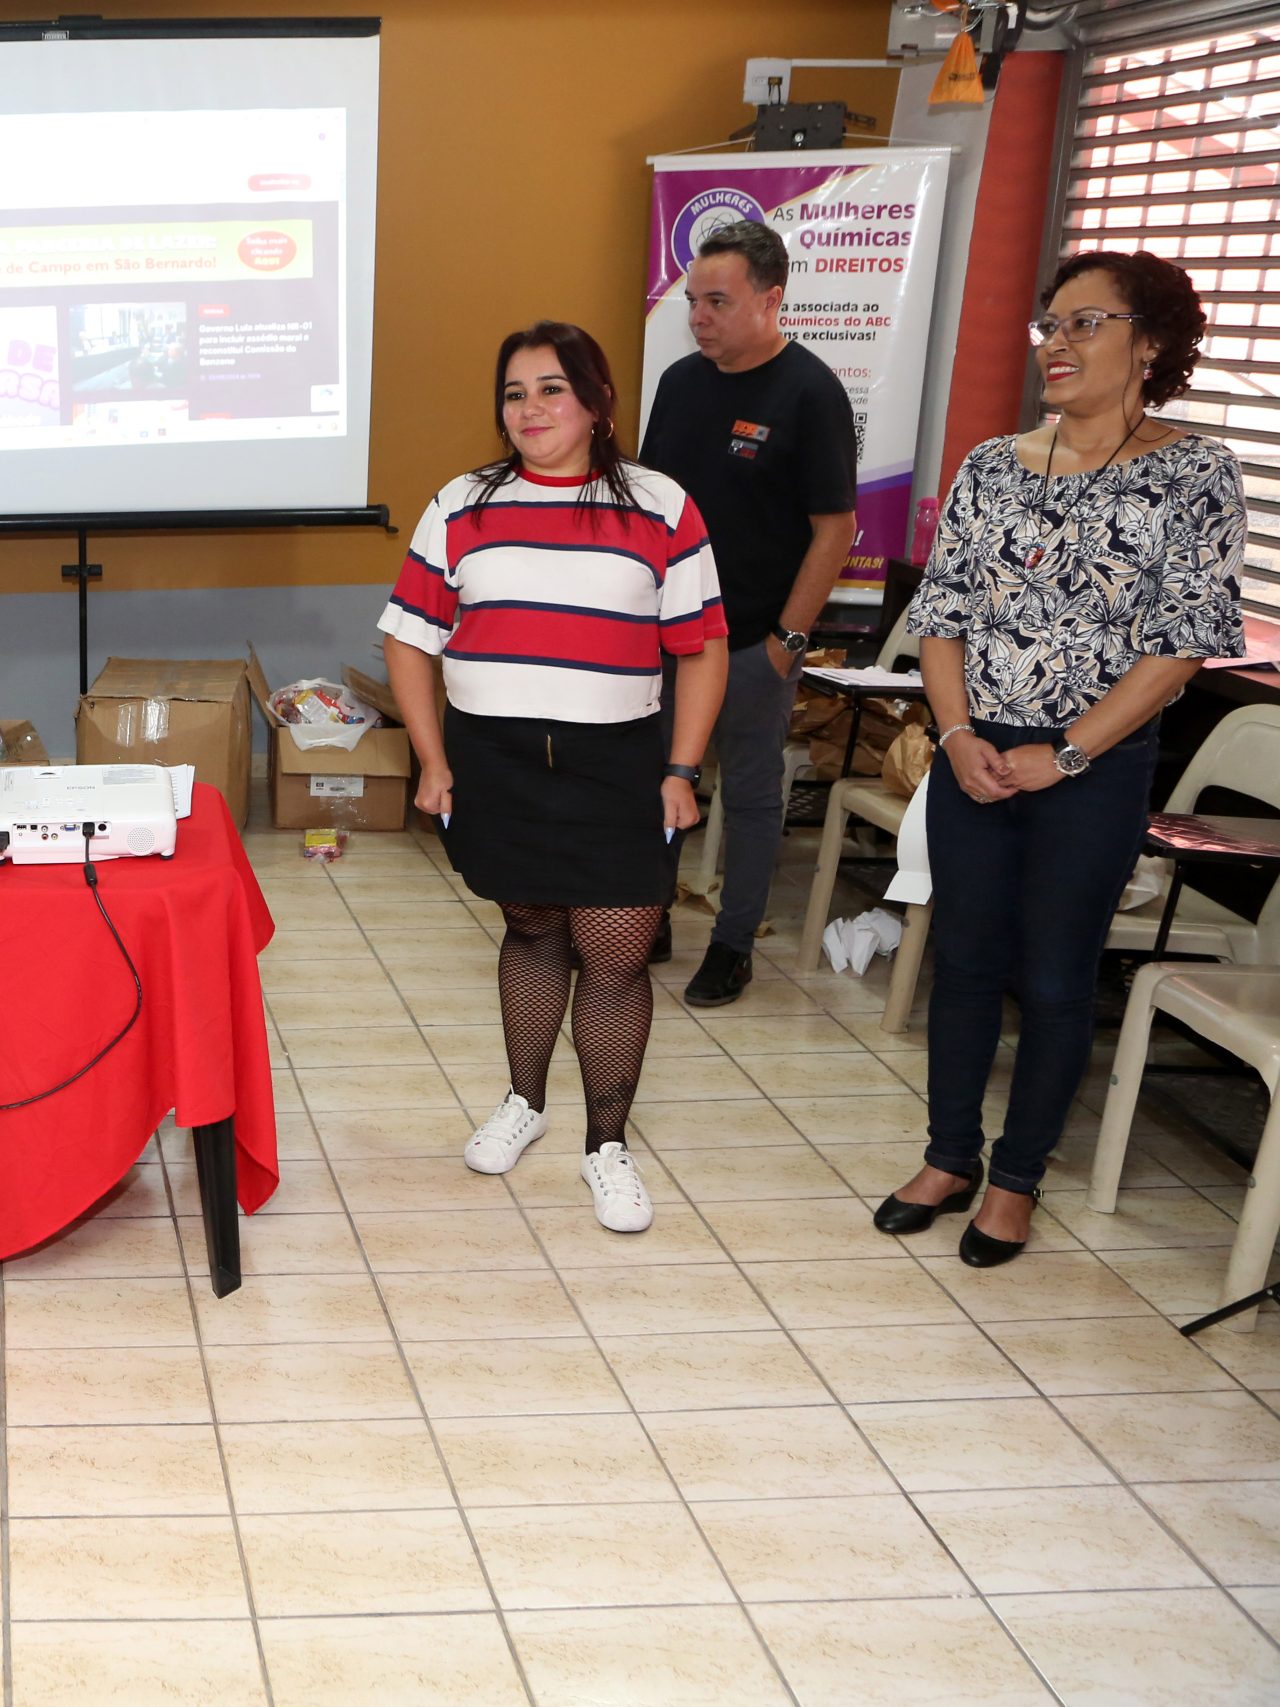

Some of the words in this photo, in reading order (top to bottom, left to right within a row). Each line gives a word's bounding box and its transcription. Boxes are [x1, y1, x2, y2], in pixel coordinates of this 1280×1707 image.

[690, 191, 753, 216] MULHERES
[773, 207, 795, 221] As
[800, 202, 916, 221] Mulheres
[800, 228, 912, 249] Químicas
[6, 261, 24, 274] de
[28, 260, 81, 276] Campo
[86, 260, 109, 272] em
[114, 257, 140, 271] São
[145, 256, 217, 270] Bernardo!
[793, 301, 858, 313] associada
[862, 303, 880, 313] ao
[779, 315, 840, 328] Químicos
[845, 316, 861, 327] do
[865, 316, 892, 327] ABC
[803, 330, 876, 342] exclusivas!
[8, 339, 57, 373] DE
